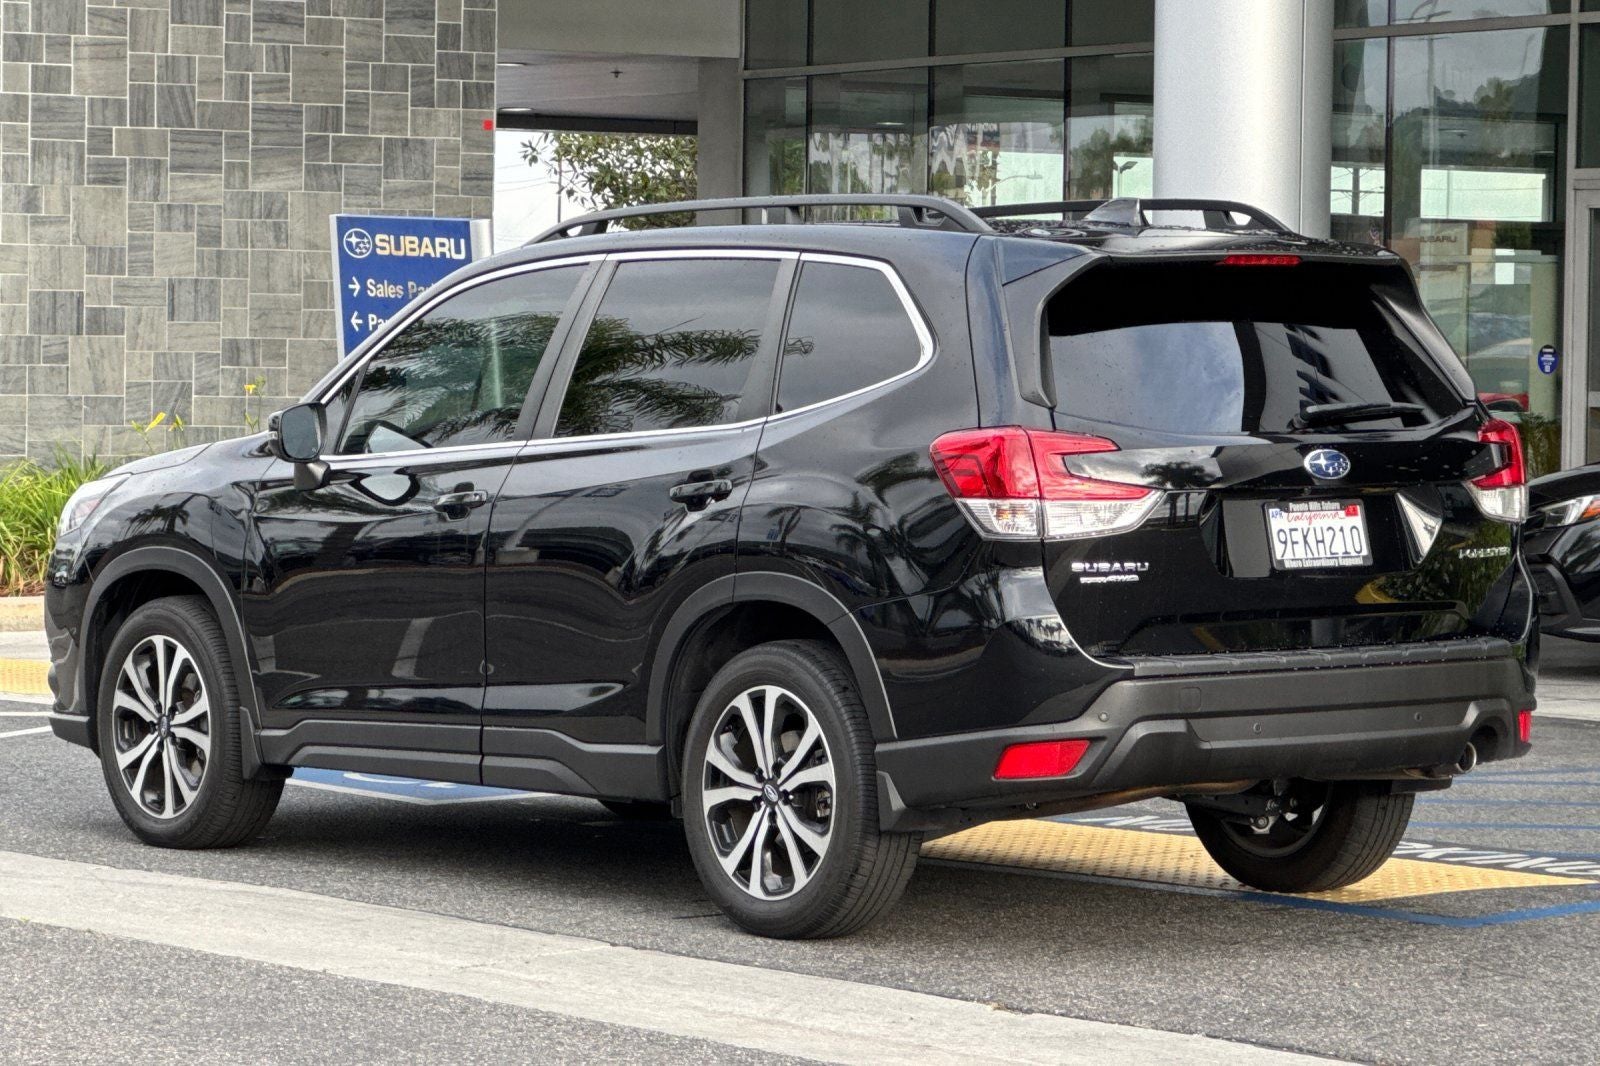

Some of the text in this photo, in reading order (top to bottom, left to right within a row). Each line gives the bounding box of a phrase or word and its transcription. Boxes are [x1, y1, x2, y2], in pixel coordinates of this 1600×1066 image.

[375, 234, 466, 259] SUBARU
[1411, 235, 1456, 243] UBARU
[366, 278, 434, 299] Sales Pa
[1287, 511, 1346, 526] California
[1277, 525, 1363, 558] 9FKH210
[1071, 562, 1149, 573] SUBARU
